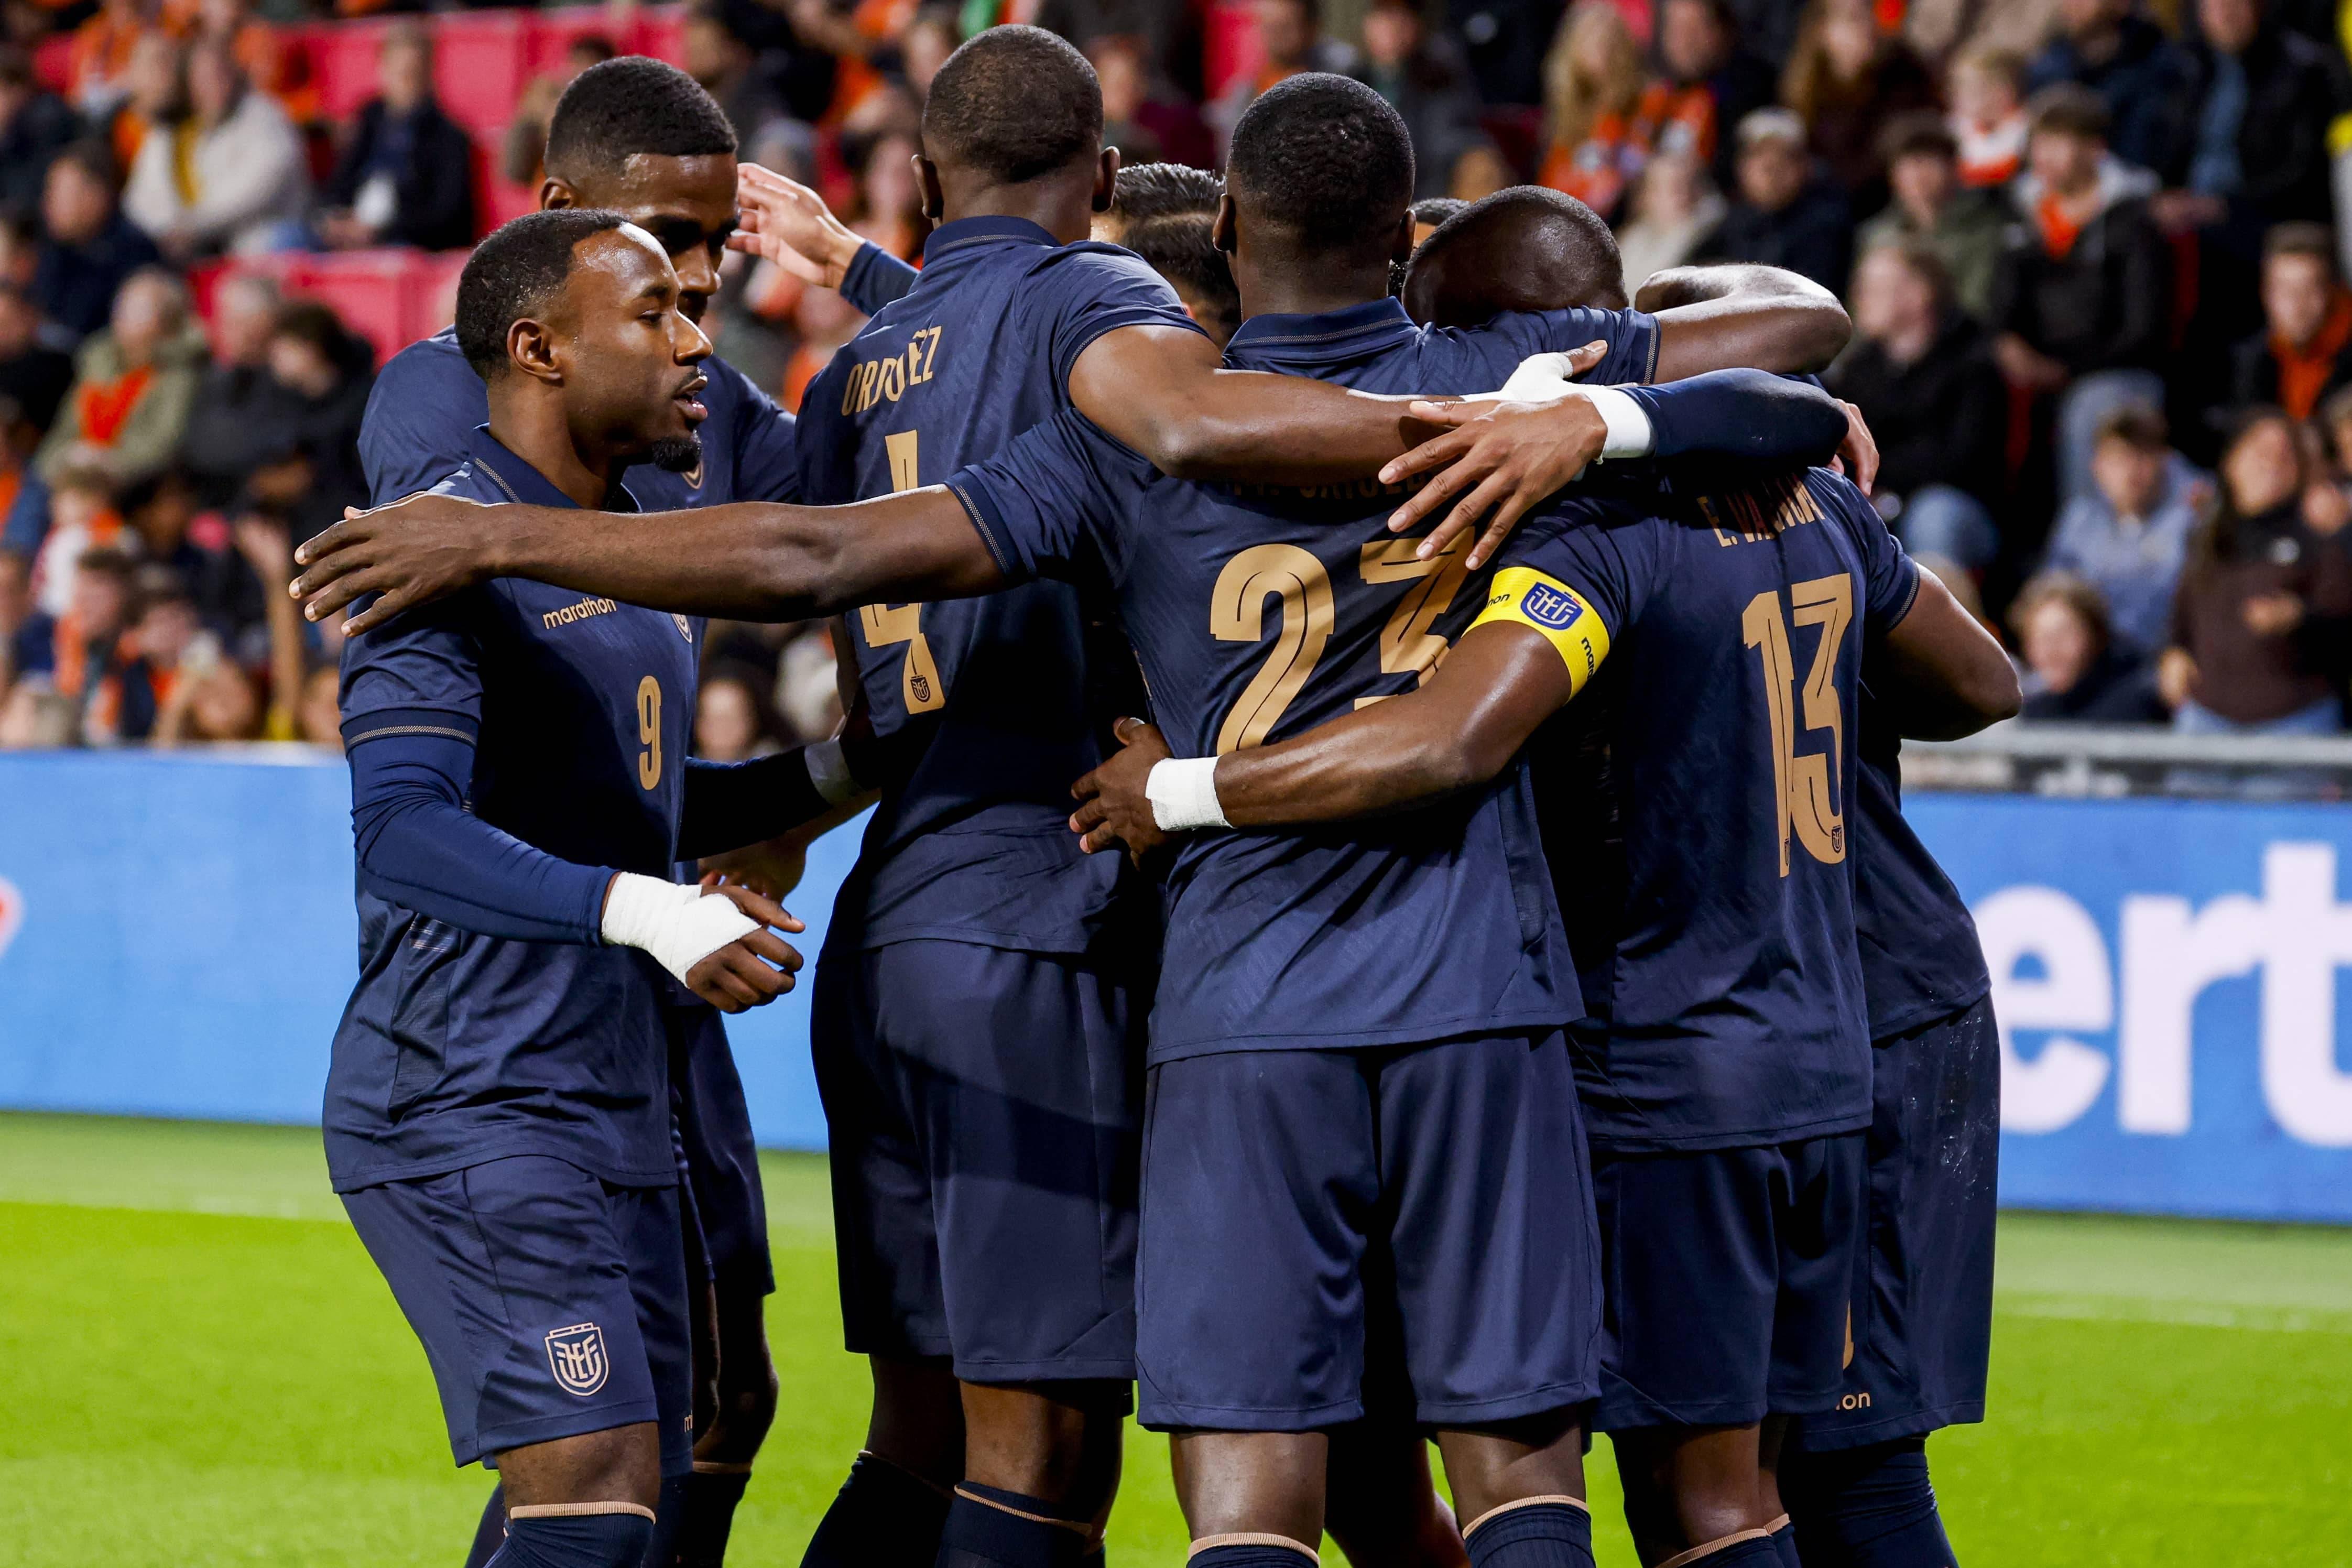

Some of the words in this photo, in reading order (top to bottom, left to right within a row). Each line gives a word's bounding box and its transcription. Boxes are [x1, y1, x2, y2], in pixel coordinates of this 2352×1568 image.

[542, 596, 617, 629] marathon
[1210, 527, 1474, 755] 23
[637, 675, 661, 790] 9
[1742, 572, 1853, 878] 13
